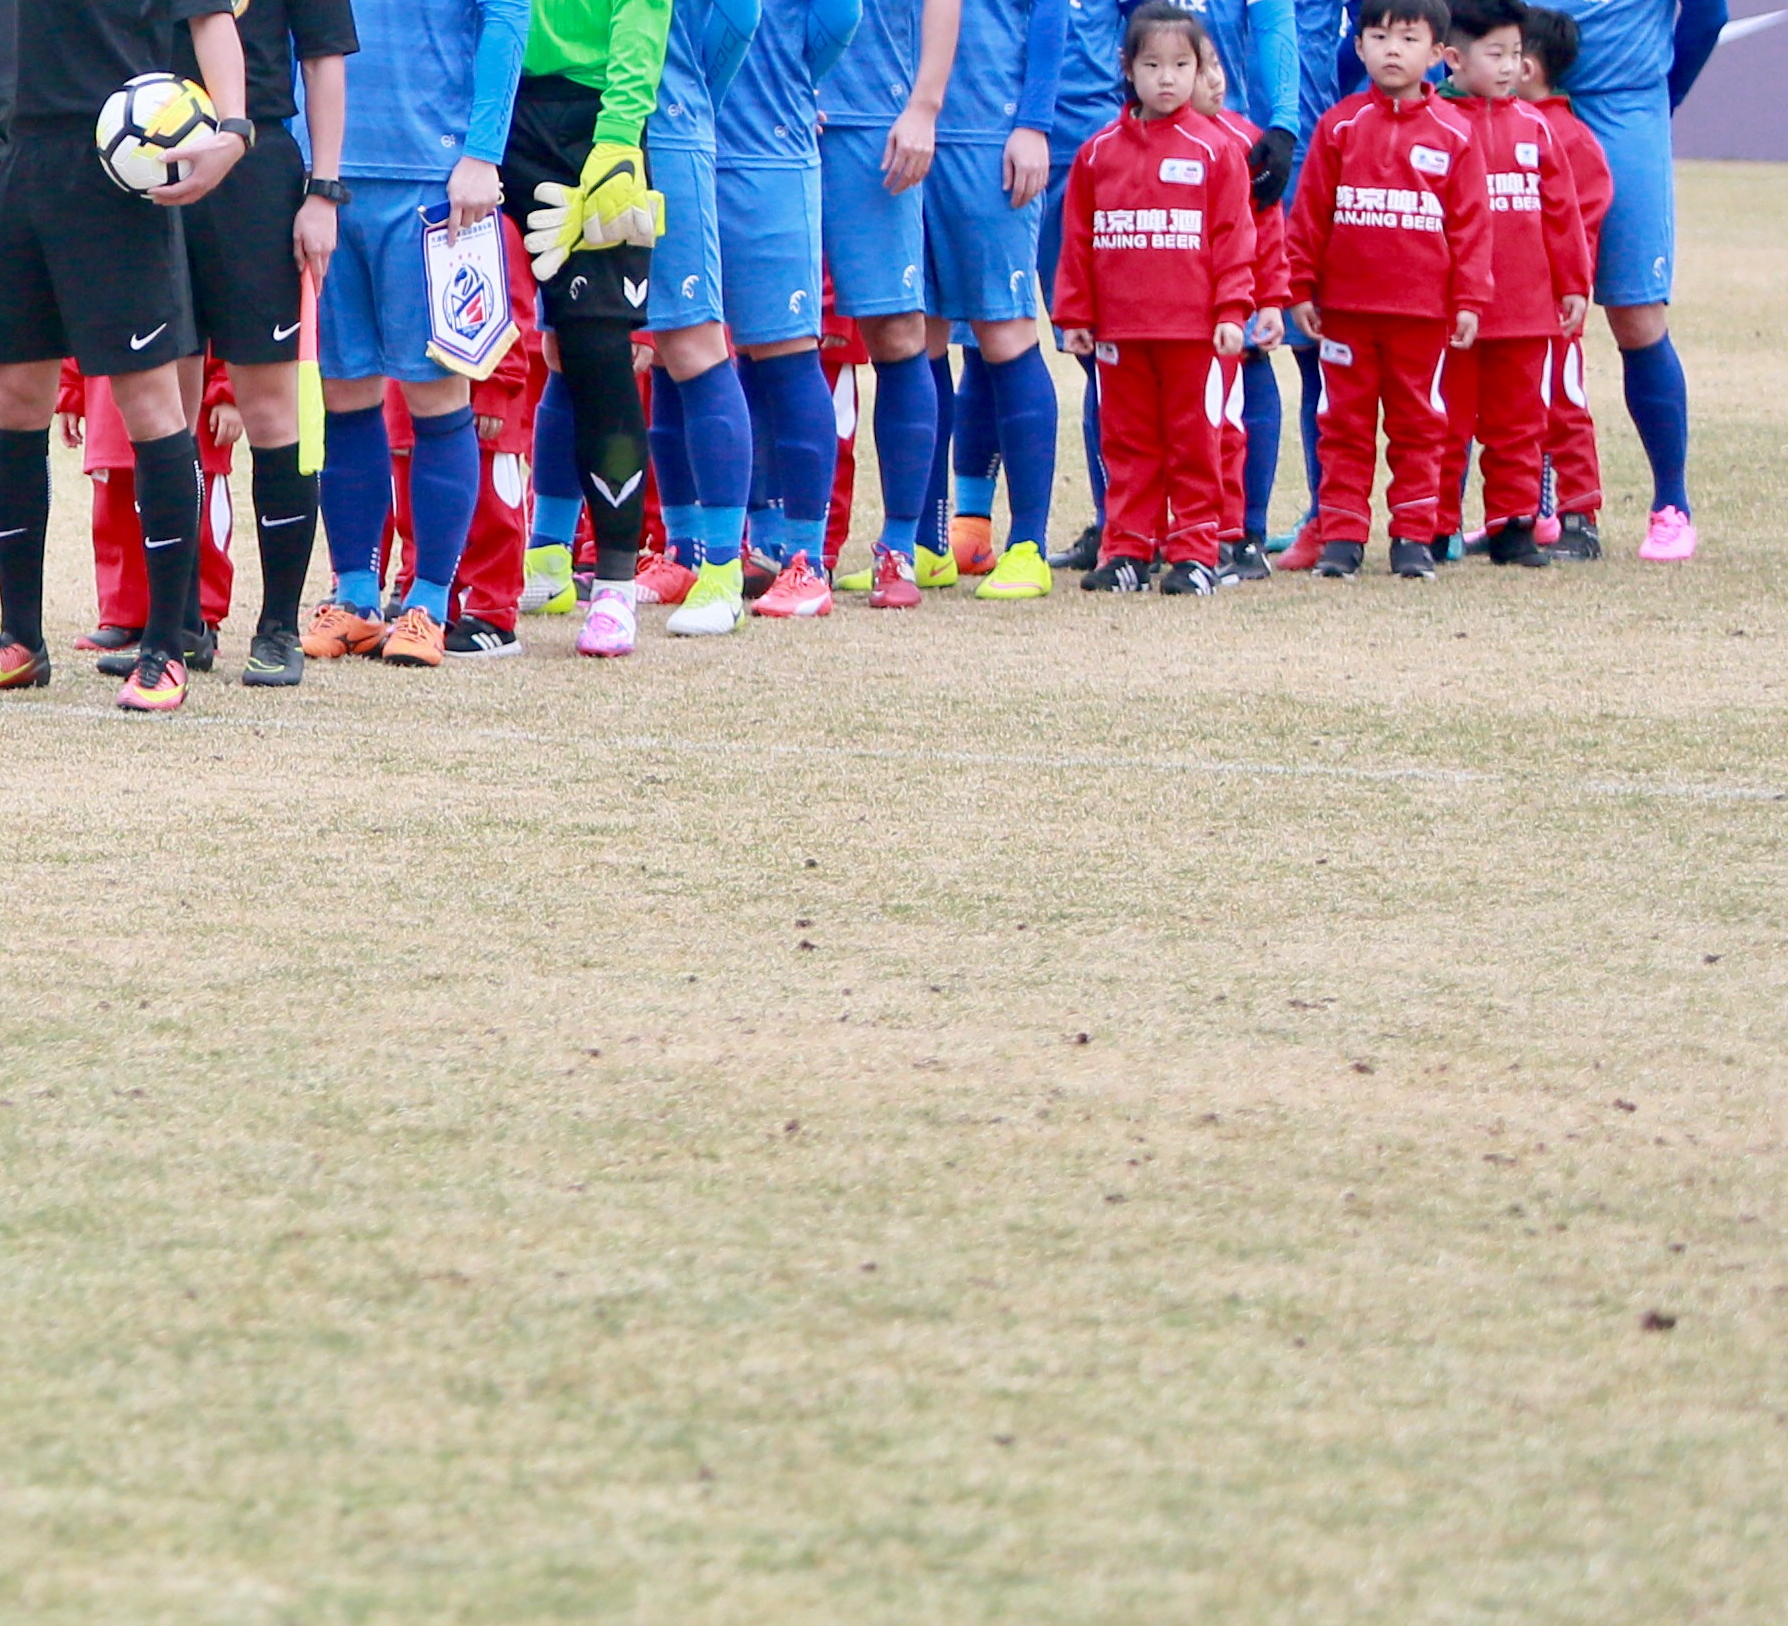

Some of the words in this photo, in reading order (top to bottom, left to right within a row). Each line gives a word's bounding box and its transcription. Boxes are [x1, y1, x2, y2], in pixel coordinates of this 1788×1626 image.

[1333, 210, 1399, 229] ANJING
[1092, 235, 1148, 251] ANJING
[1151, 234, 1202, 251] BEER
